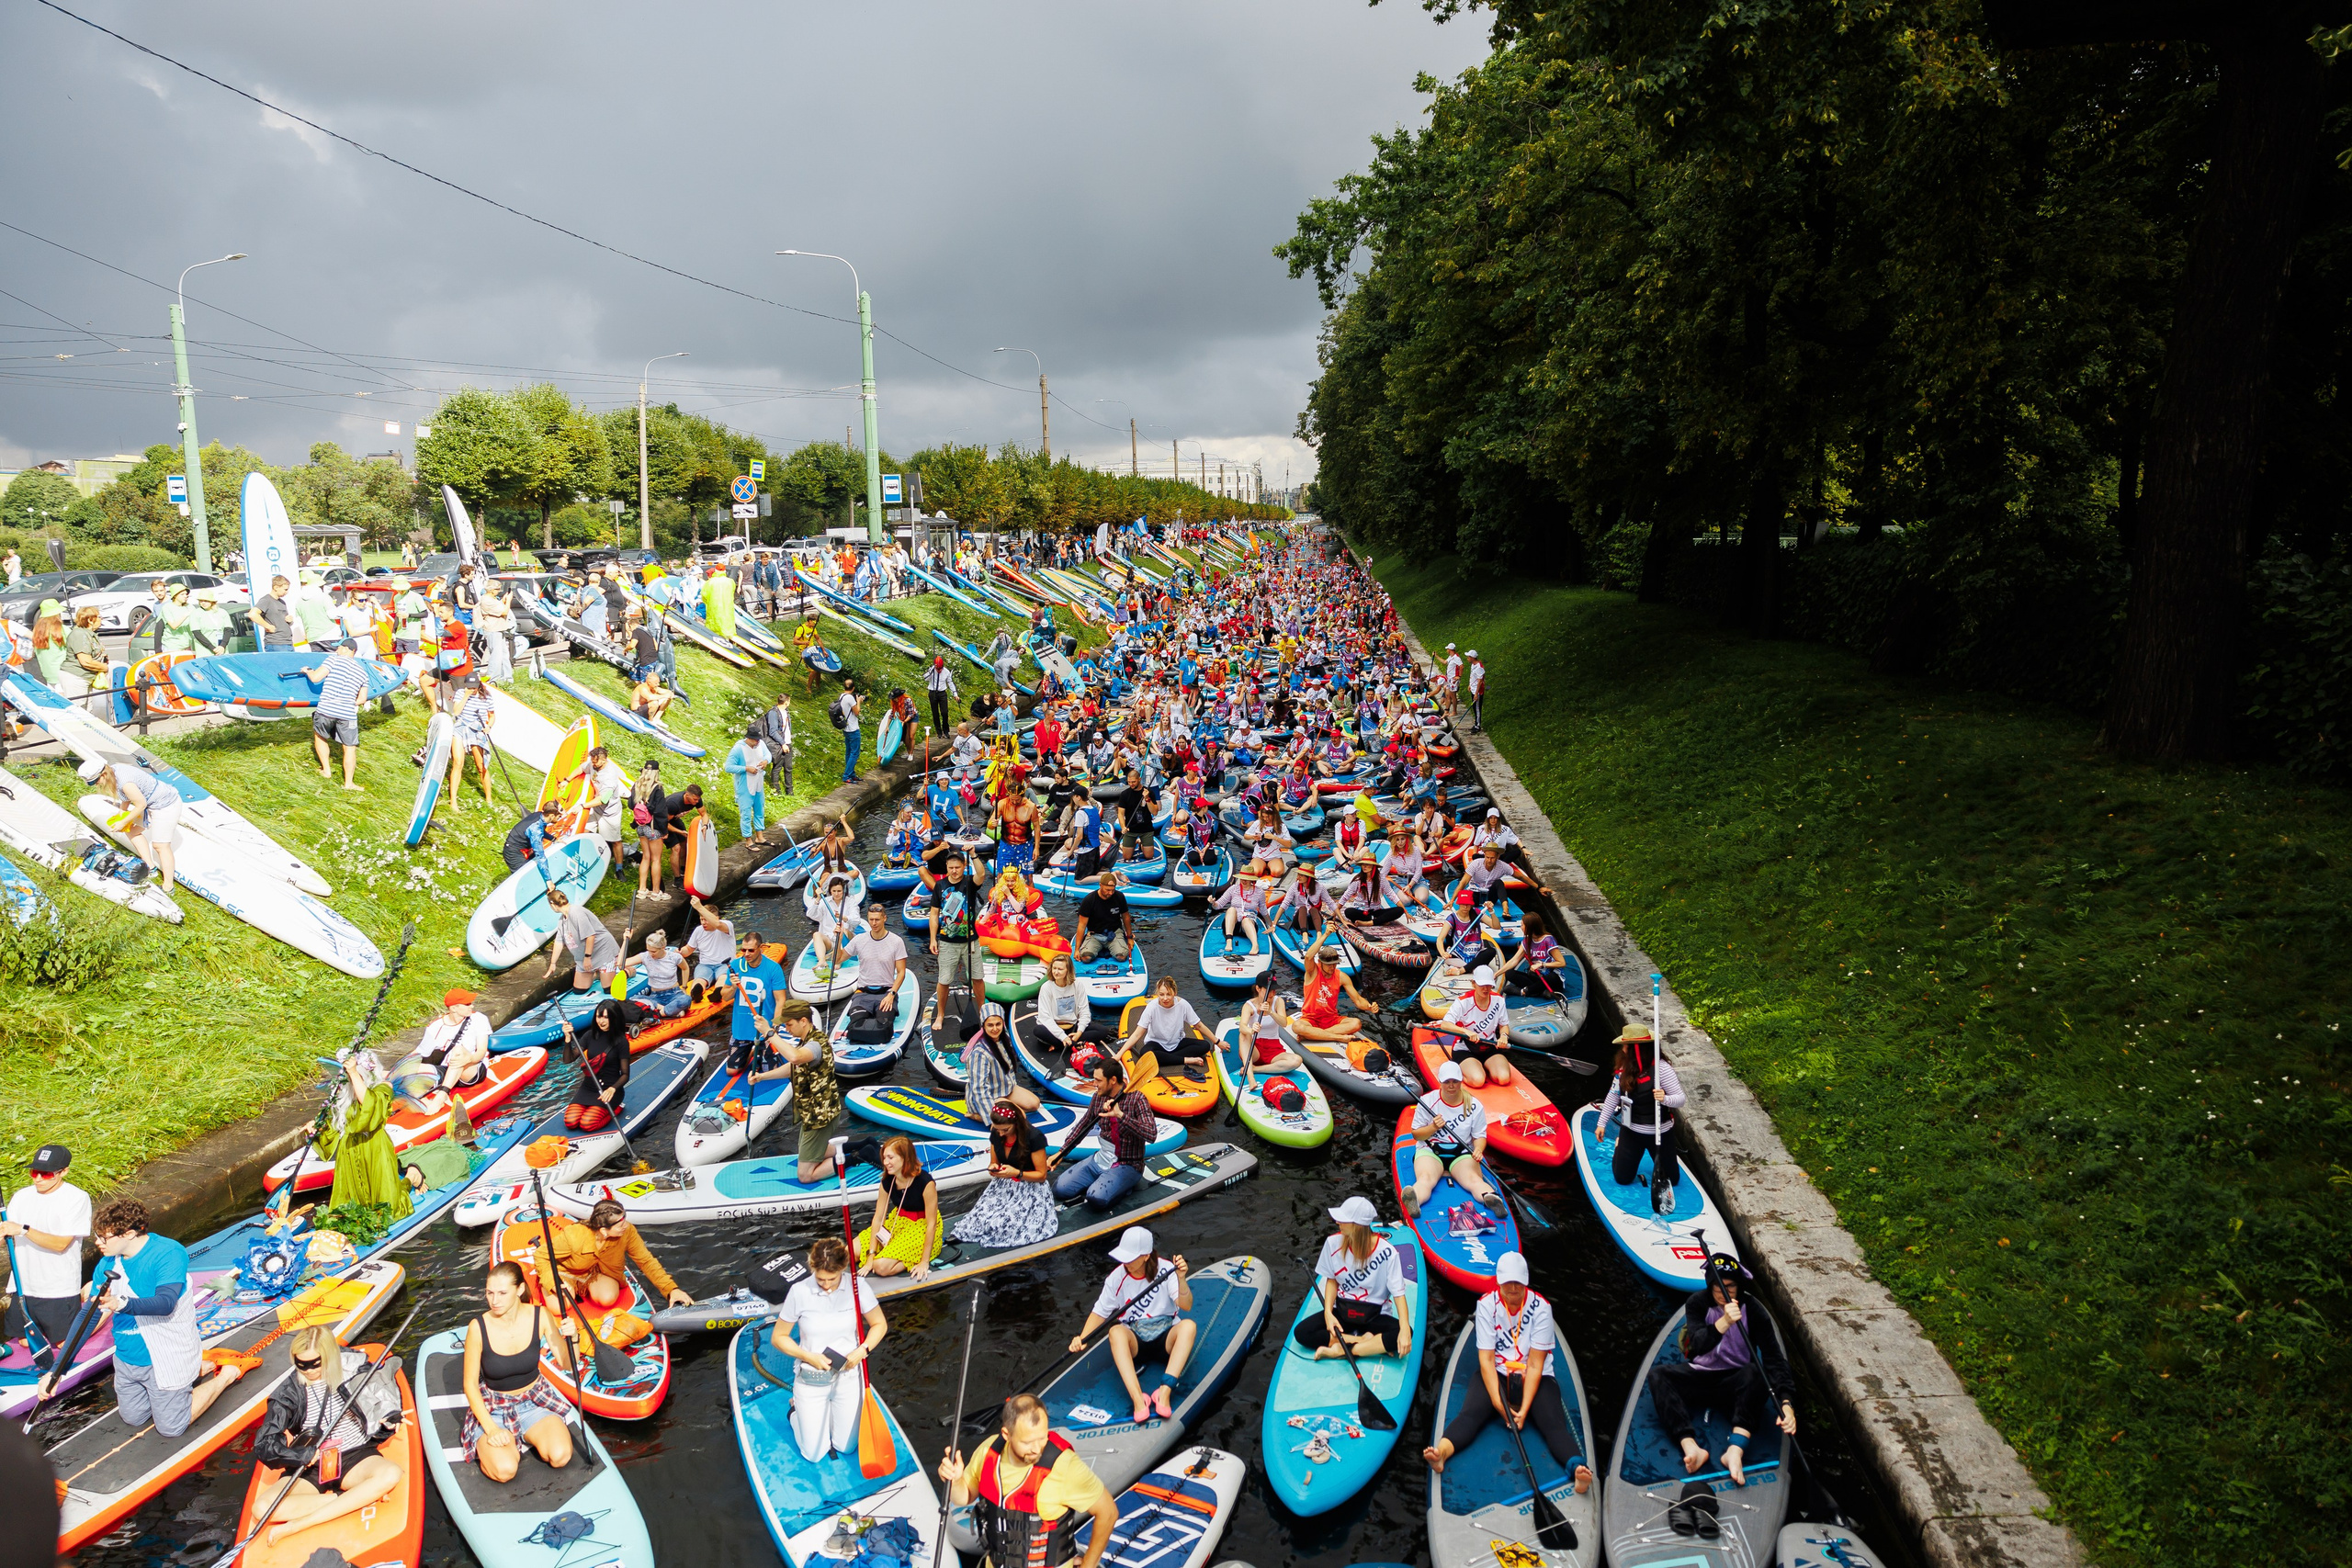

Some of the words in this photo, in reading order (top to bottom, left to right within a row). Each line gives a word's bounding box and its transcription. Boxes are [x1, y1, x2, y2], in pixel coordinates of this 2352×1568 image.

[717, 1208, 753, 1219] FOCUS
[757, 1206, 777, 1216] SUP
[718, 1318, 744, 1329] BODY
[1076, 1420, 1161, 1440] GLADIATOR
[1471, 1506, 1496, 1519] ORIGIN
